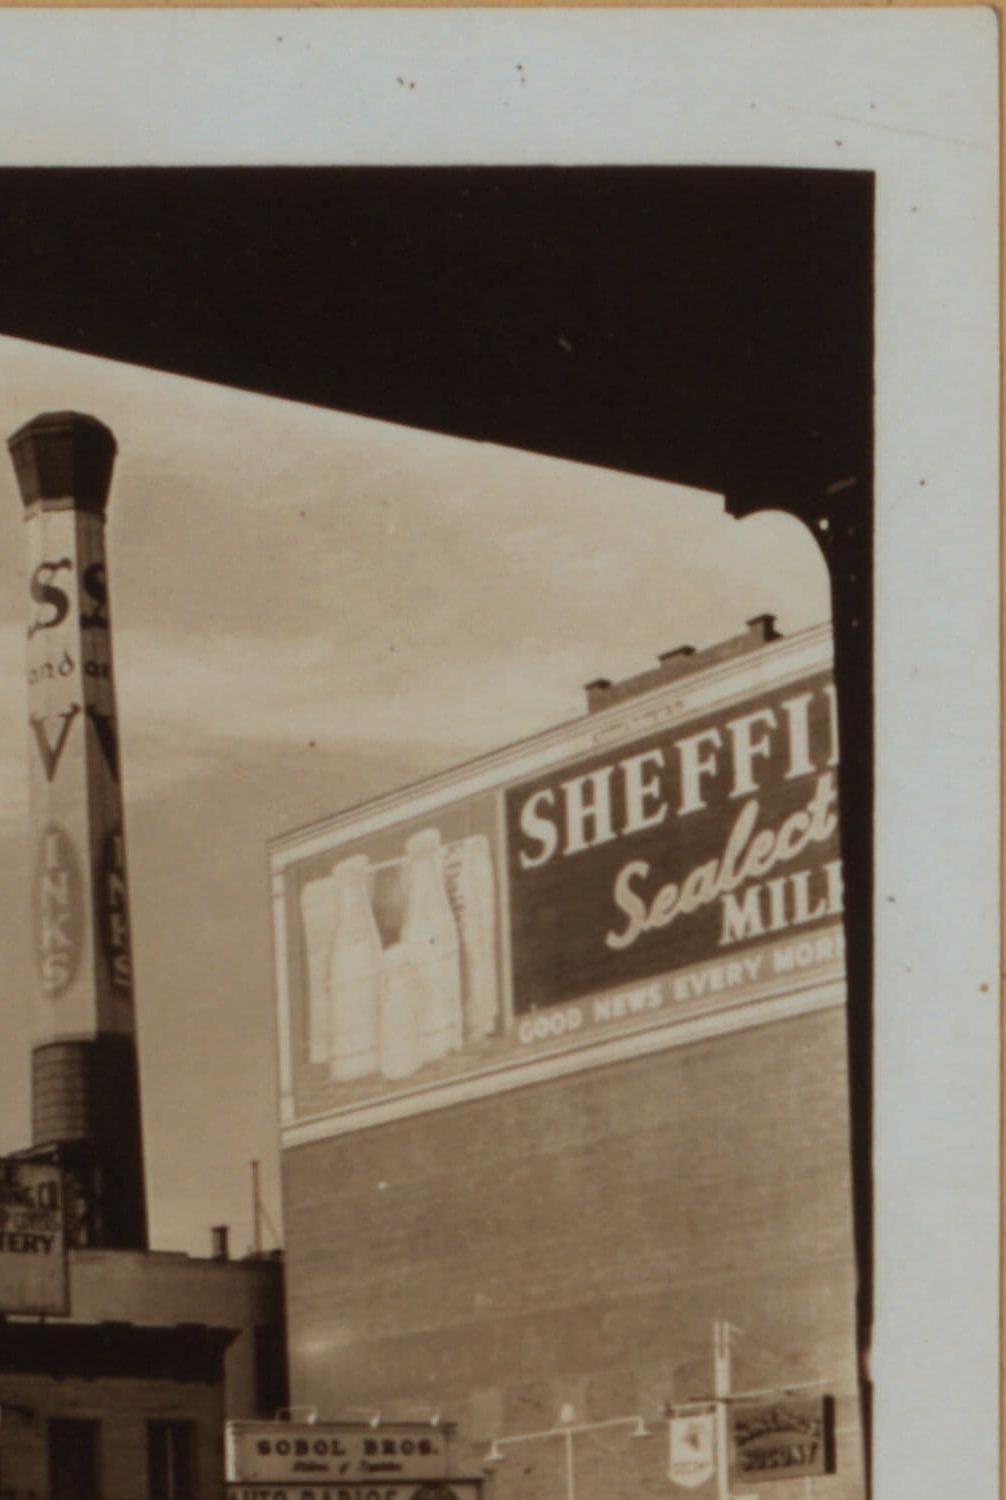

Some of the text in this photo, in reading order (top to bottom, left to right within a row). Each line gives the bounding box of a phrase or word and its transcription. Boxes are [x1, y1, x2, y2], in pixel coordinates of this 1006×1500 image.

[28, 557, 73, 640] S
[28, 652, 74, 685] and
[29, 702, 81, 783] V
[519, 1006, 582, 1045] GOOD
[594, 983, 663, 1023] NEWS
[673, 955, 762, 1001] EVERY
[256, 1438, 440, 1457] SOBOL BROS.
